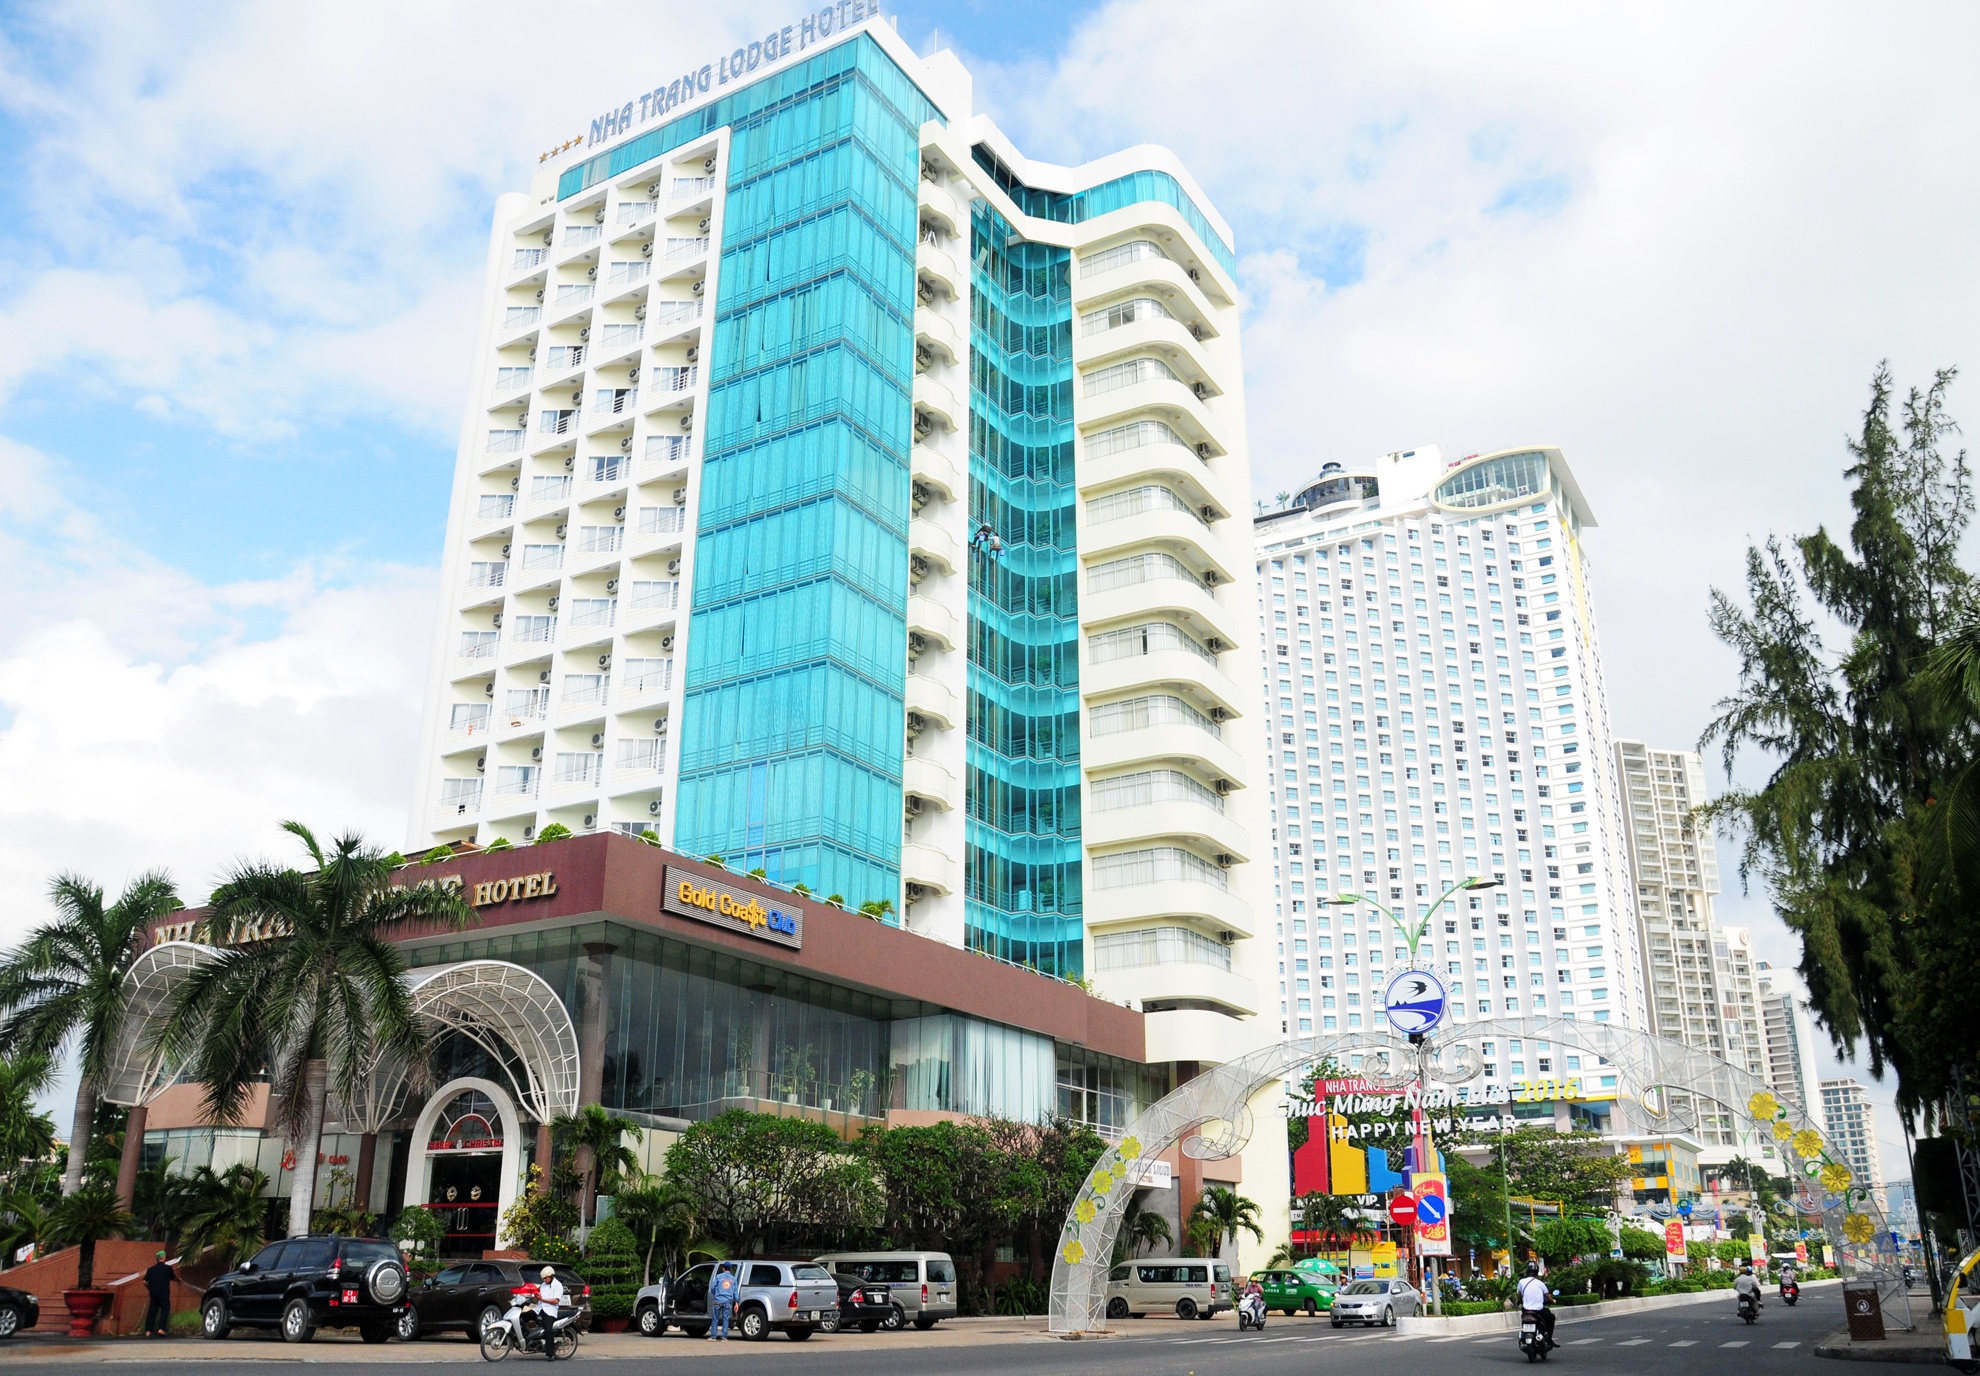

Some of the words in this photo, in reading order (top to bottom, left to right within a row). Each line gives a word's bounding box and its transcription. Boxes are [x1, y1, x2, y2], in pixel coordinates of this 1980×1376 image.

[588, 101, 634, 147] NHA
[639, 64, 711, 123] TRANG
[718, 25, 793, 86] LODGE
[800, 0, 878, 51] HOTEL
[472, 870, 557, 907] HOTEL
[678, 881, 716, 911] Gold
[768, 909, 796, 935] Club
[1325, 1080, 1346, 1093] NHA
[1349, 1079, 1380, 1092] TRANG
[1516, 1077, 1580, 1103] 2016
[1332, 1122, 1399, 1140] HAPPY
[1405, 1117, 1451, 1135] NEW
[1456, 1114, 1517, 1133] YEAR
[1357, 1195, 1378, 1205] VIP
